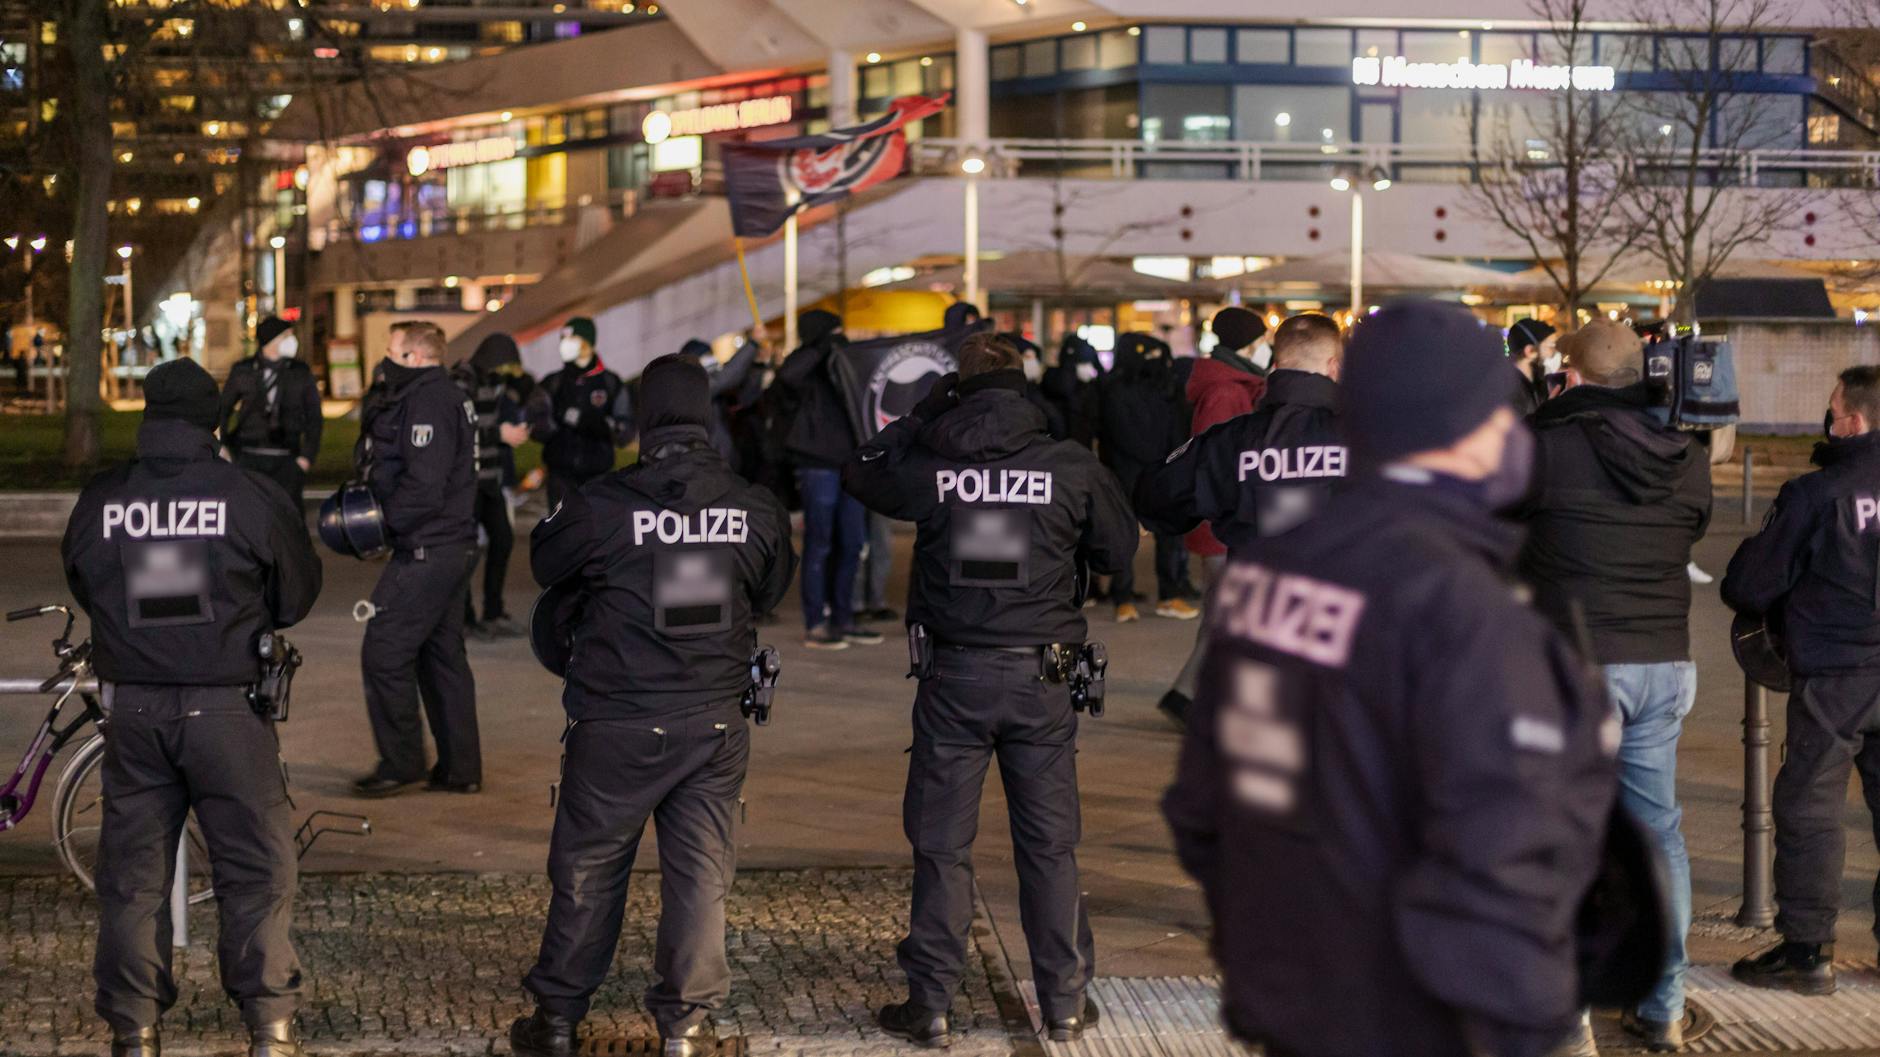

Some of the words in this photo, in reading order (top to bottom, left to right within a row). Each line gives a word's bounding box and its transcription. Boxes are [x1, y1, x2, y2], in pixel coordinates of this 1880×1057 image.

[1238, 446, 1347, 482] POLIZEI
[936, 468, 1053, 504] POLIZEI
[103, 501, 226, 538] POLIZEI
[633, 508, 749, 545] POLIZEI
[1856, 499, 1880, 530] P
[1217, 563, 1367, 669] POLIZEI
